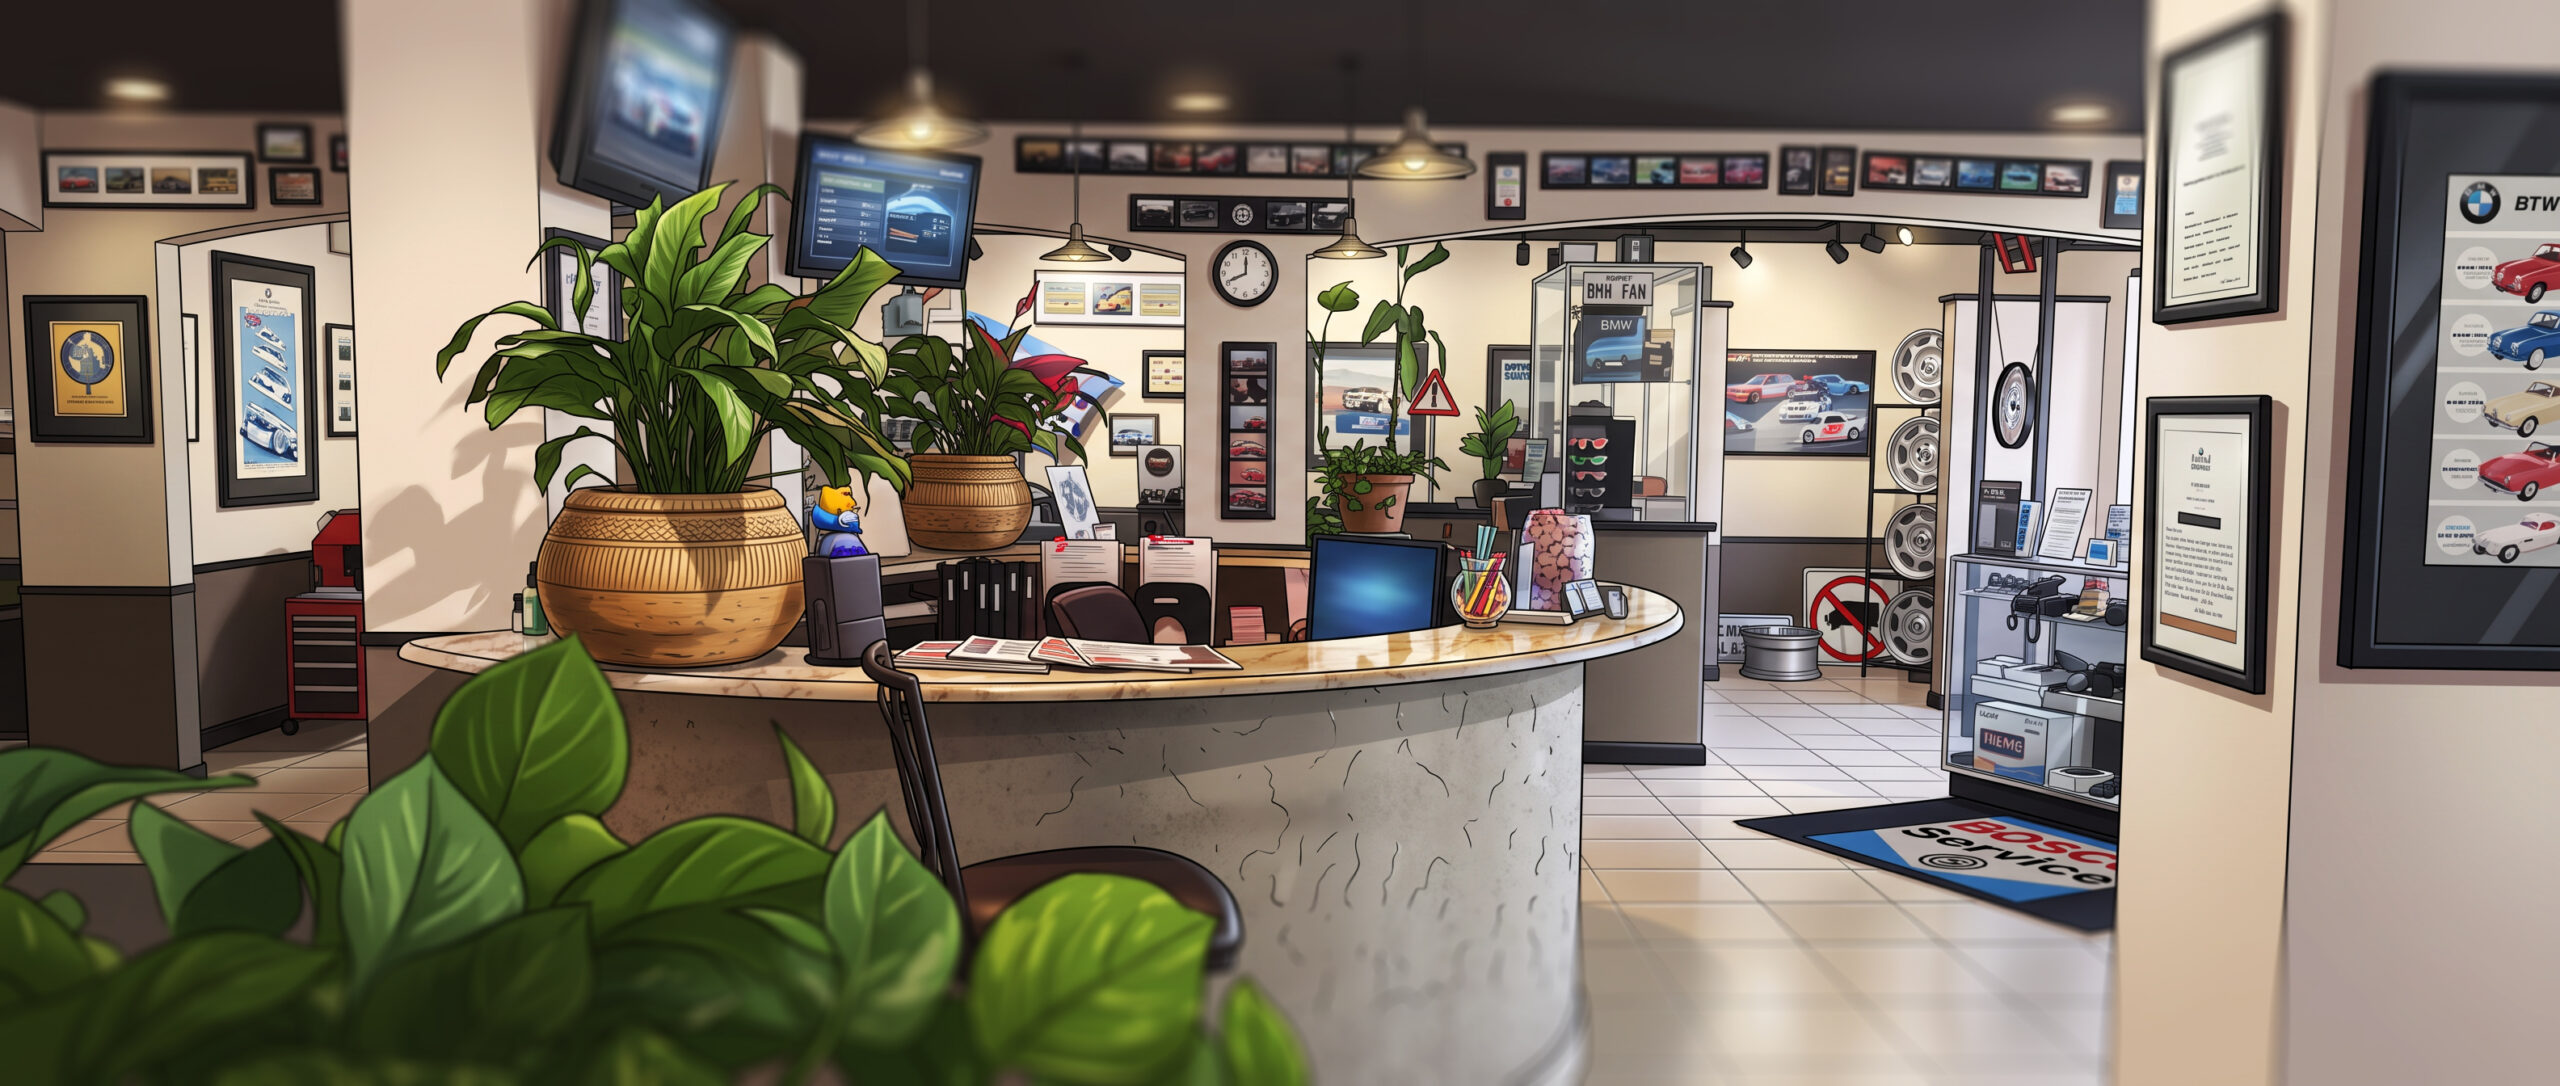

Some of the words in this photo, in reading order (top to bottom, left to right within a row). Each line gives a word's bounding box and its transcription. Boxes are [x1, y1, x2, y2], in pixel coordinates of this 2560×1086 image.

[1622, 283, 1646, 299] FAN
[1601, 319, 1633, 330] BMW
[1901, 827, 2112, 884] Service
[1948, 820, 2118, 870] BOSC
